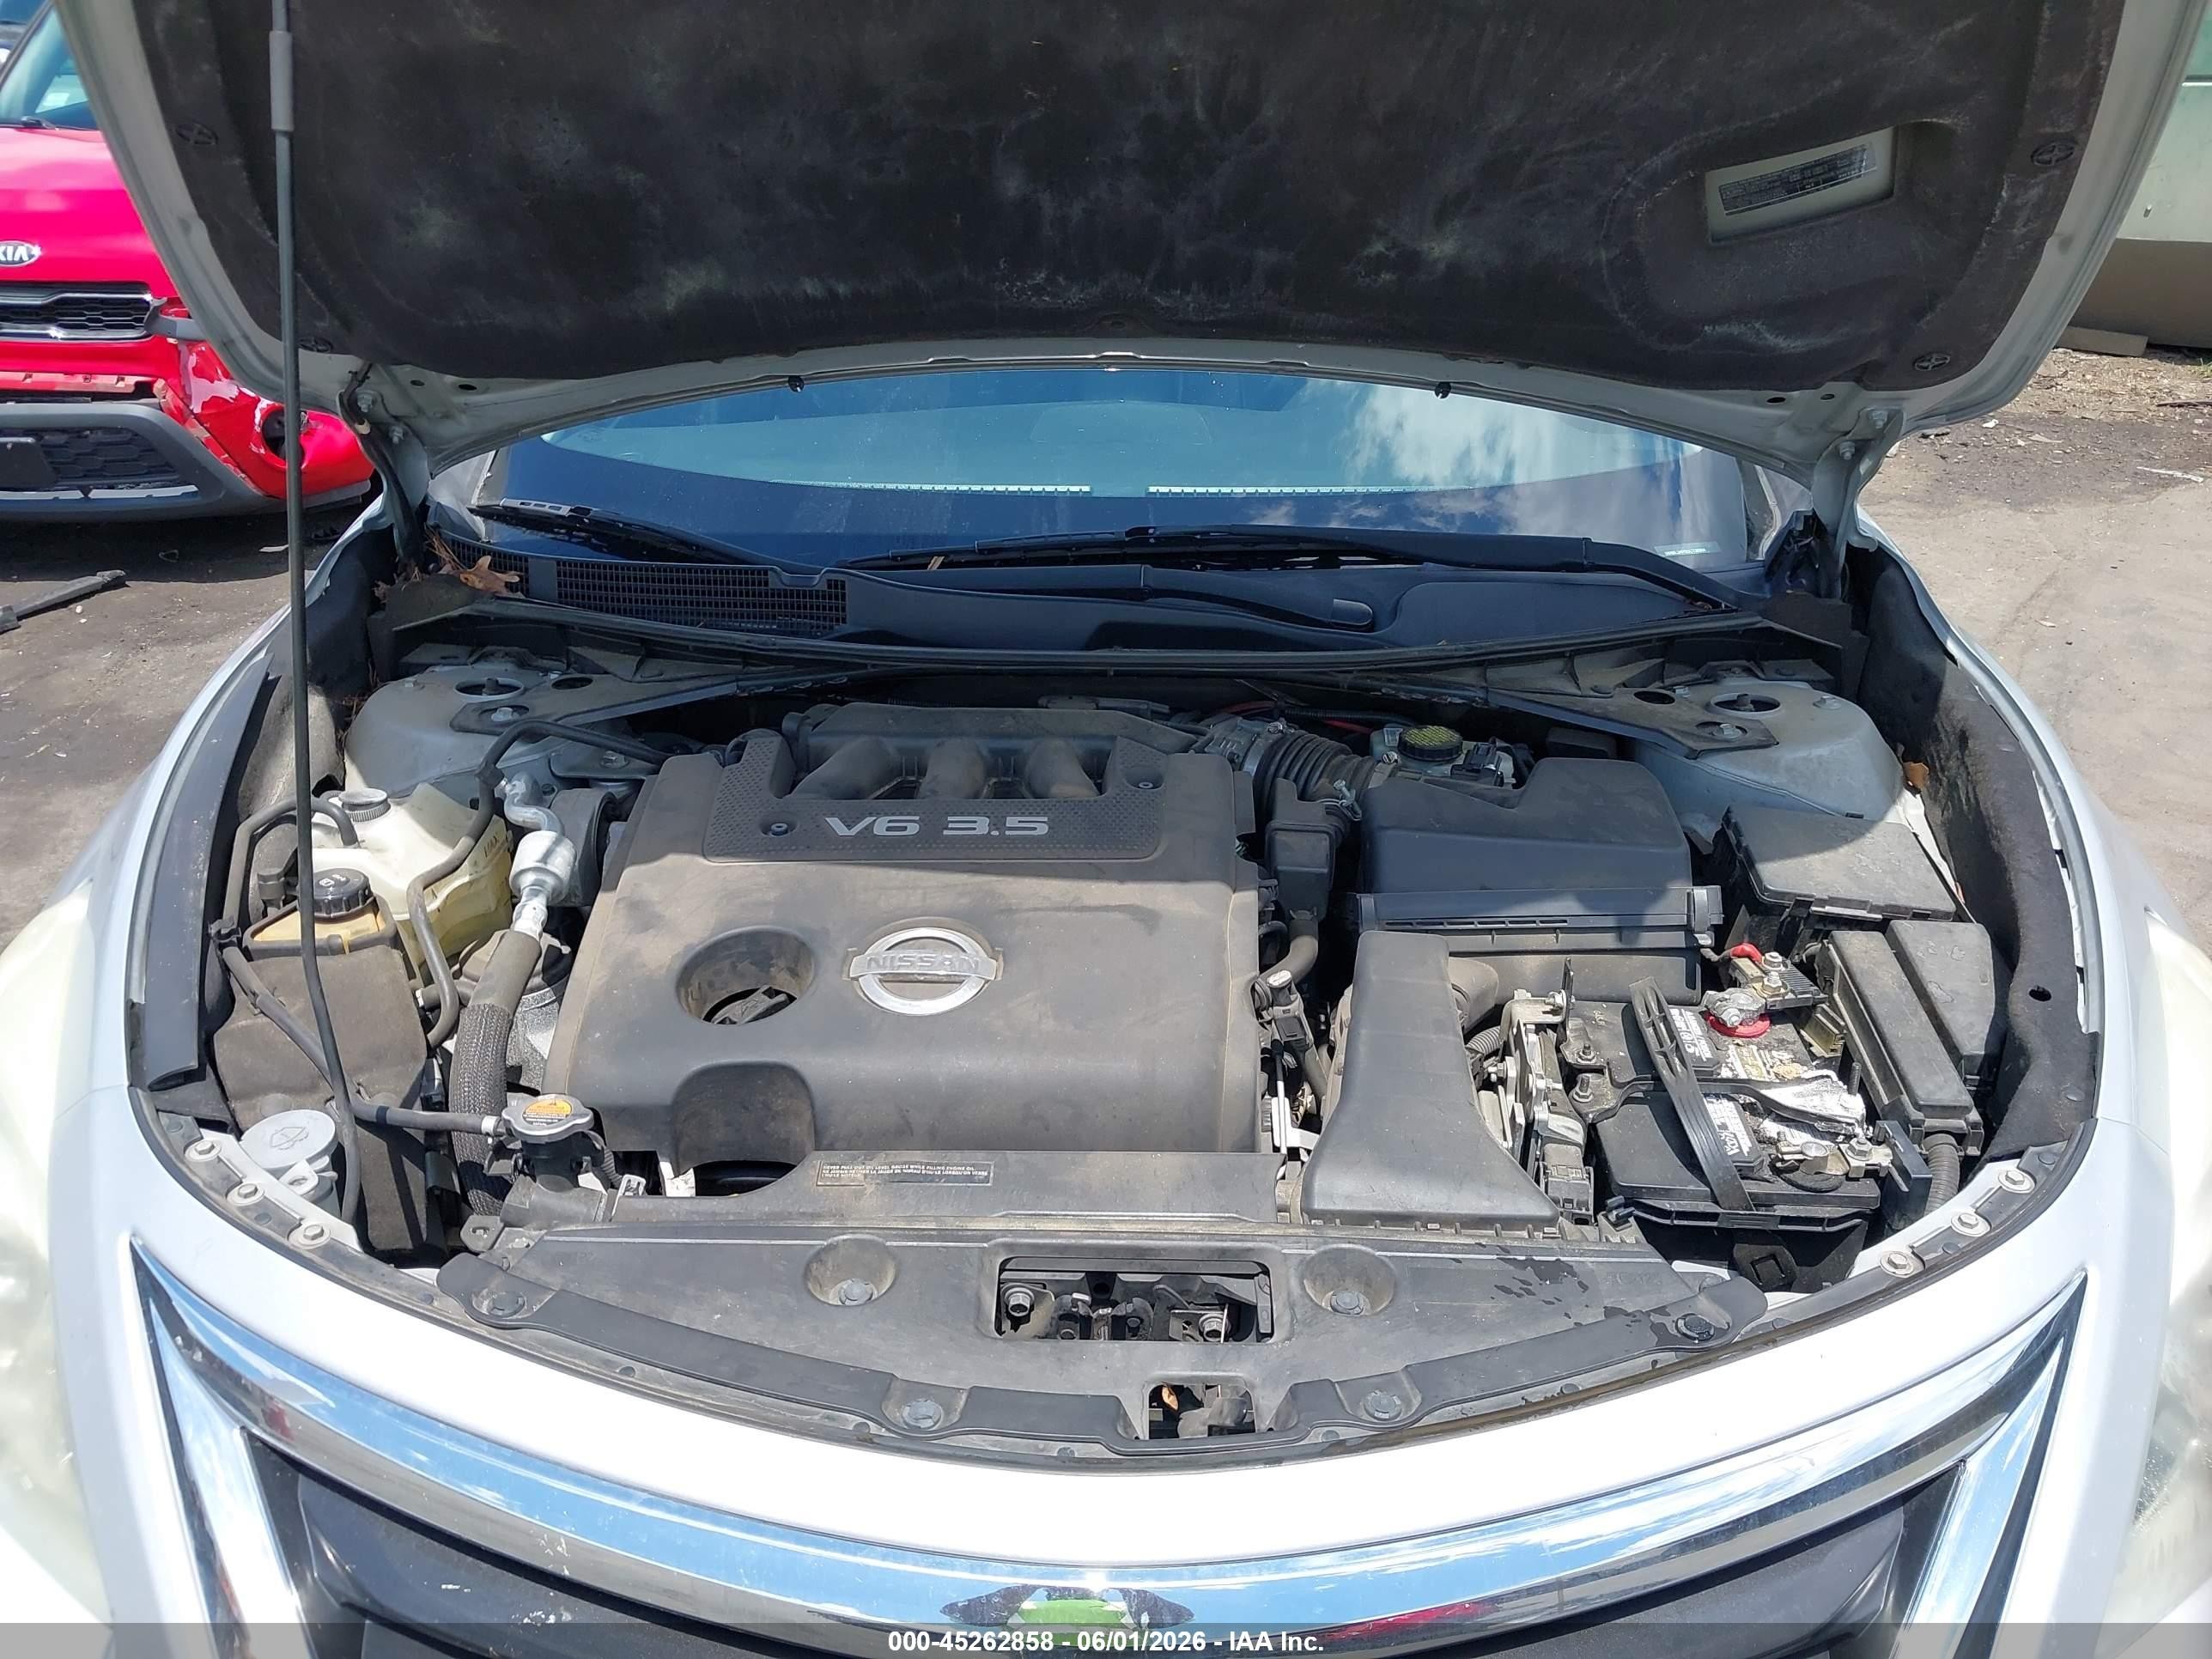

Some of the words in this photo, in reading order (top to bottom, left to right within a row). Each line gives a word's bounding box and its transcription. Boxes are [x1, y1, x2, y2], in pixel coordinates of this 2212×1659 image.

[825, 816, 921, 836] V6
[943, 816, 1049, 836] 3.5
[866, 954, 981, 971] NISSAN
